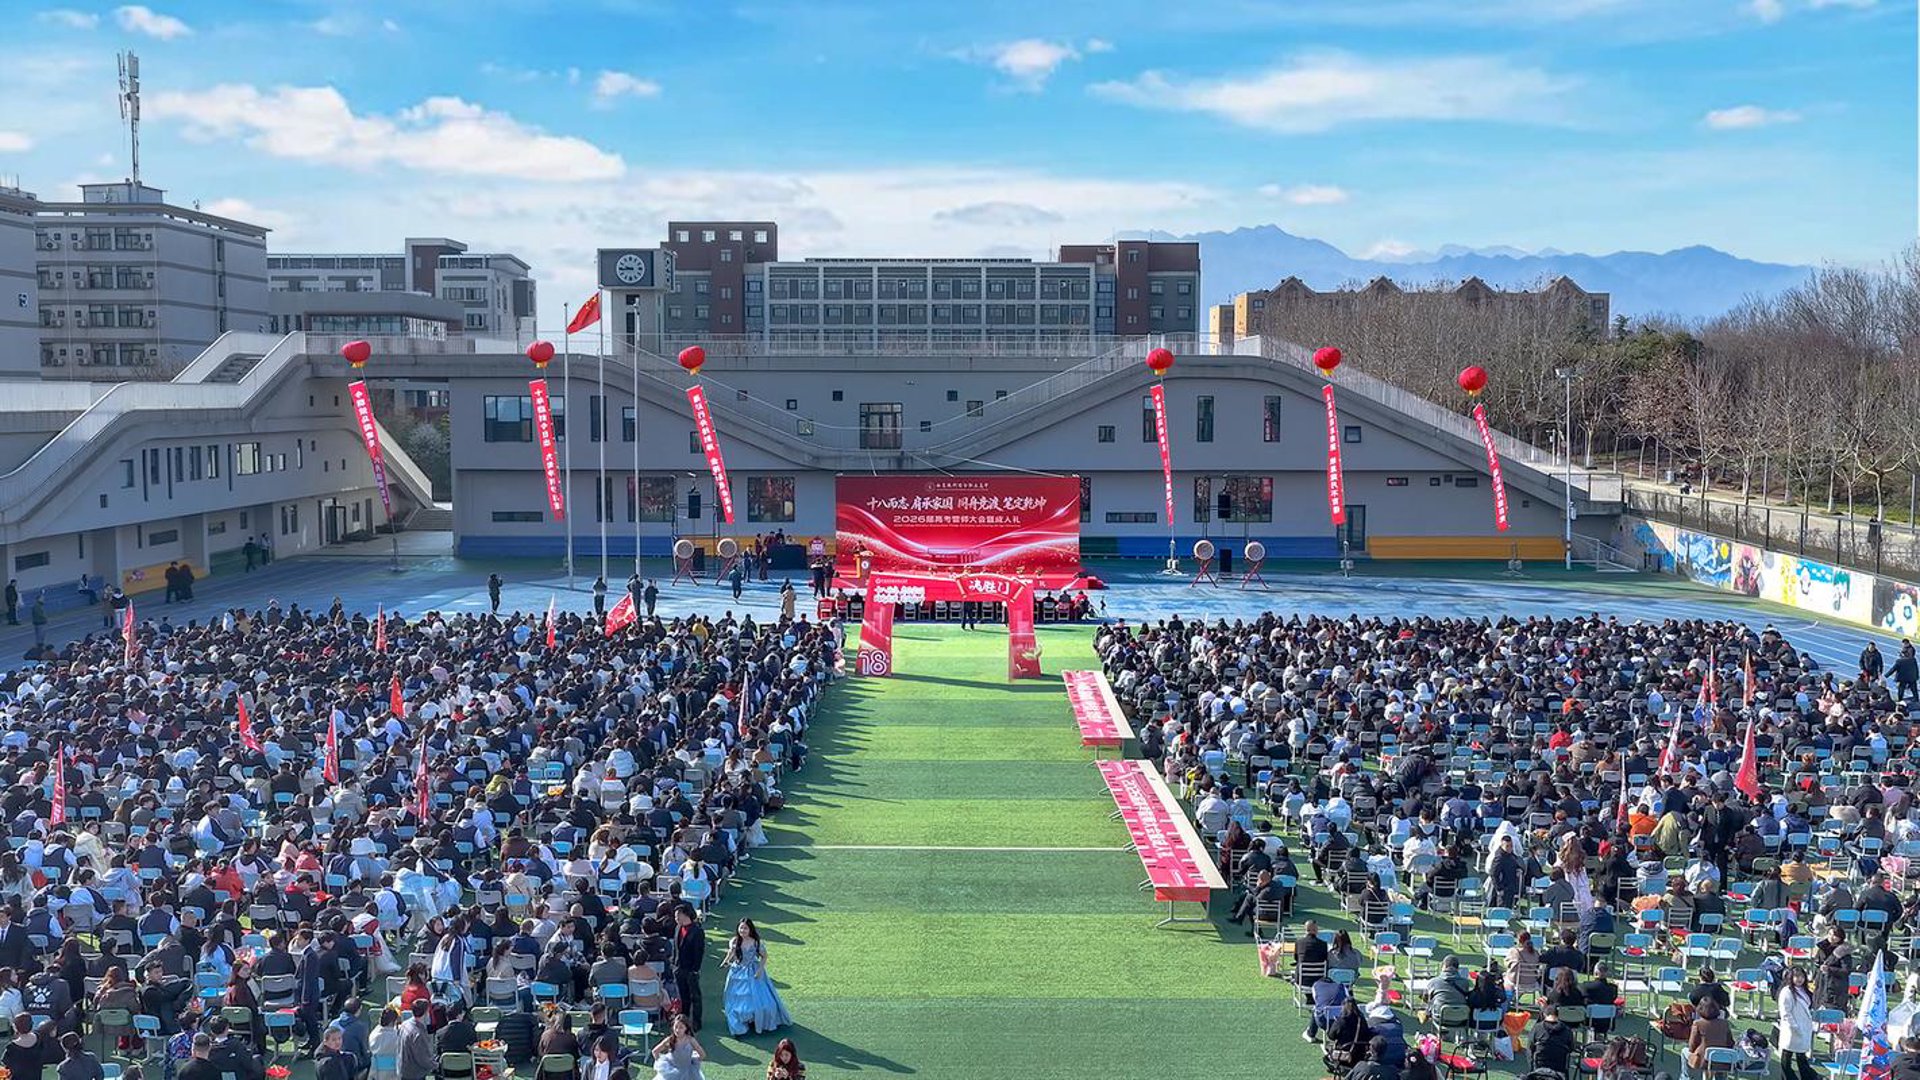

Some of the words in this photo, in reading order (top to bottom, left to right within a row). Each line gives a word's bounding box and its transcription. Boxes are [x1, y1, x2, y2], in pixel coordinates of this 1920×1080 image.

[866, 496, 910, 511] 十八而志
[969, 578, 1010, 595] 决胜门
[858, 649, 887, 676] 18
